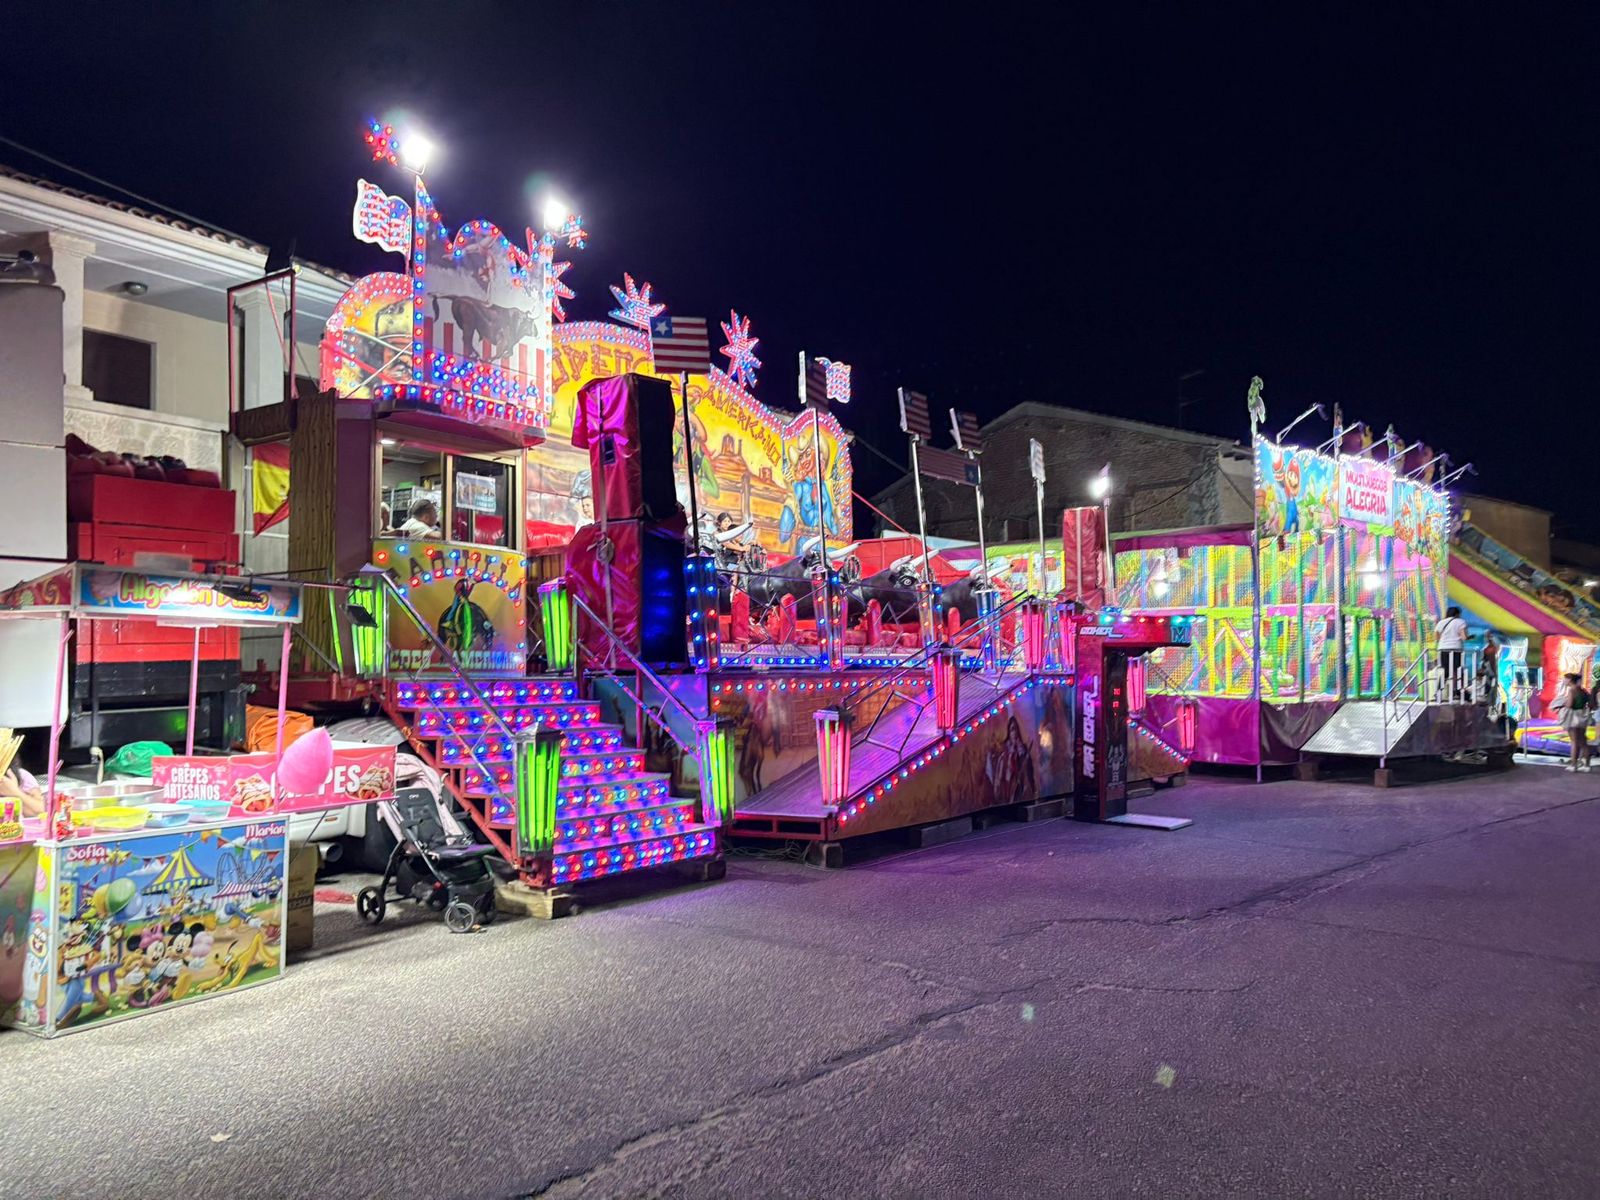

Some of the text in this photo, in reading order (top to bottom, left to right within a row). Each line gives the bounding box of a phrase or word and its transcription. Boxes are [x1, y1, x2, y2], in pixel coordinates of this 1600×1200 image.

[1346, 487, 1387, 516] ALEGRIA
[171, 762, 209, 784] CRÊPES
[163, 783, 220, 800] ARTESANOS
